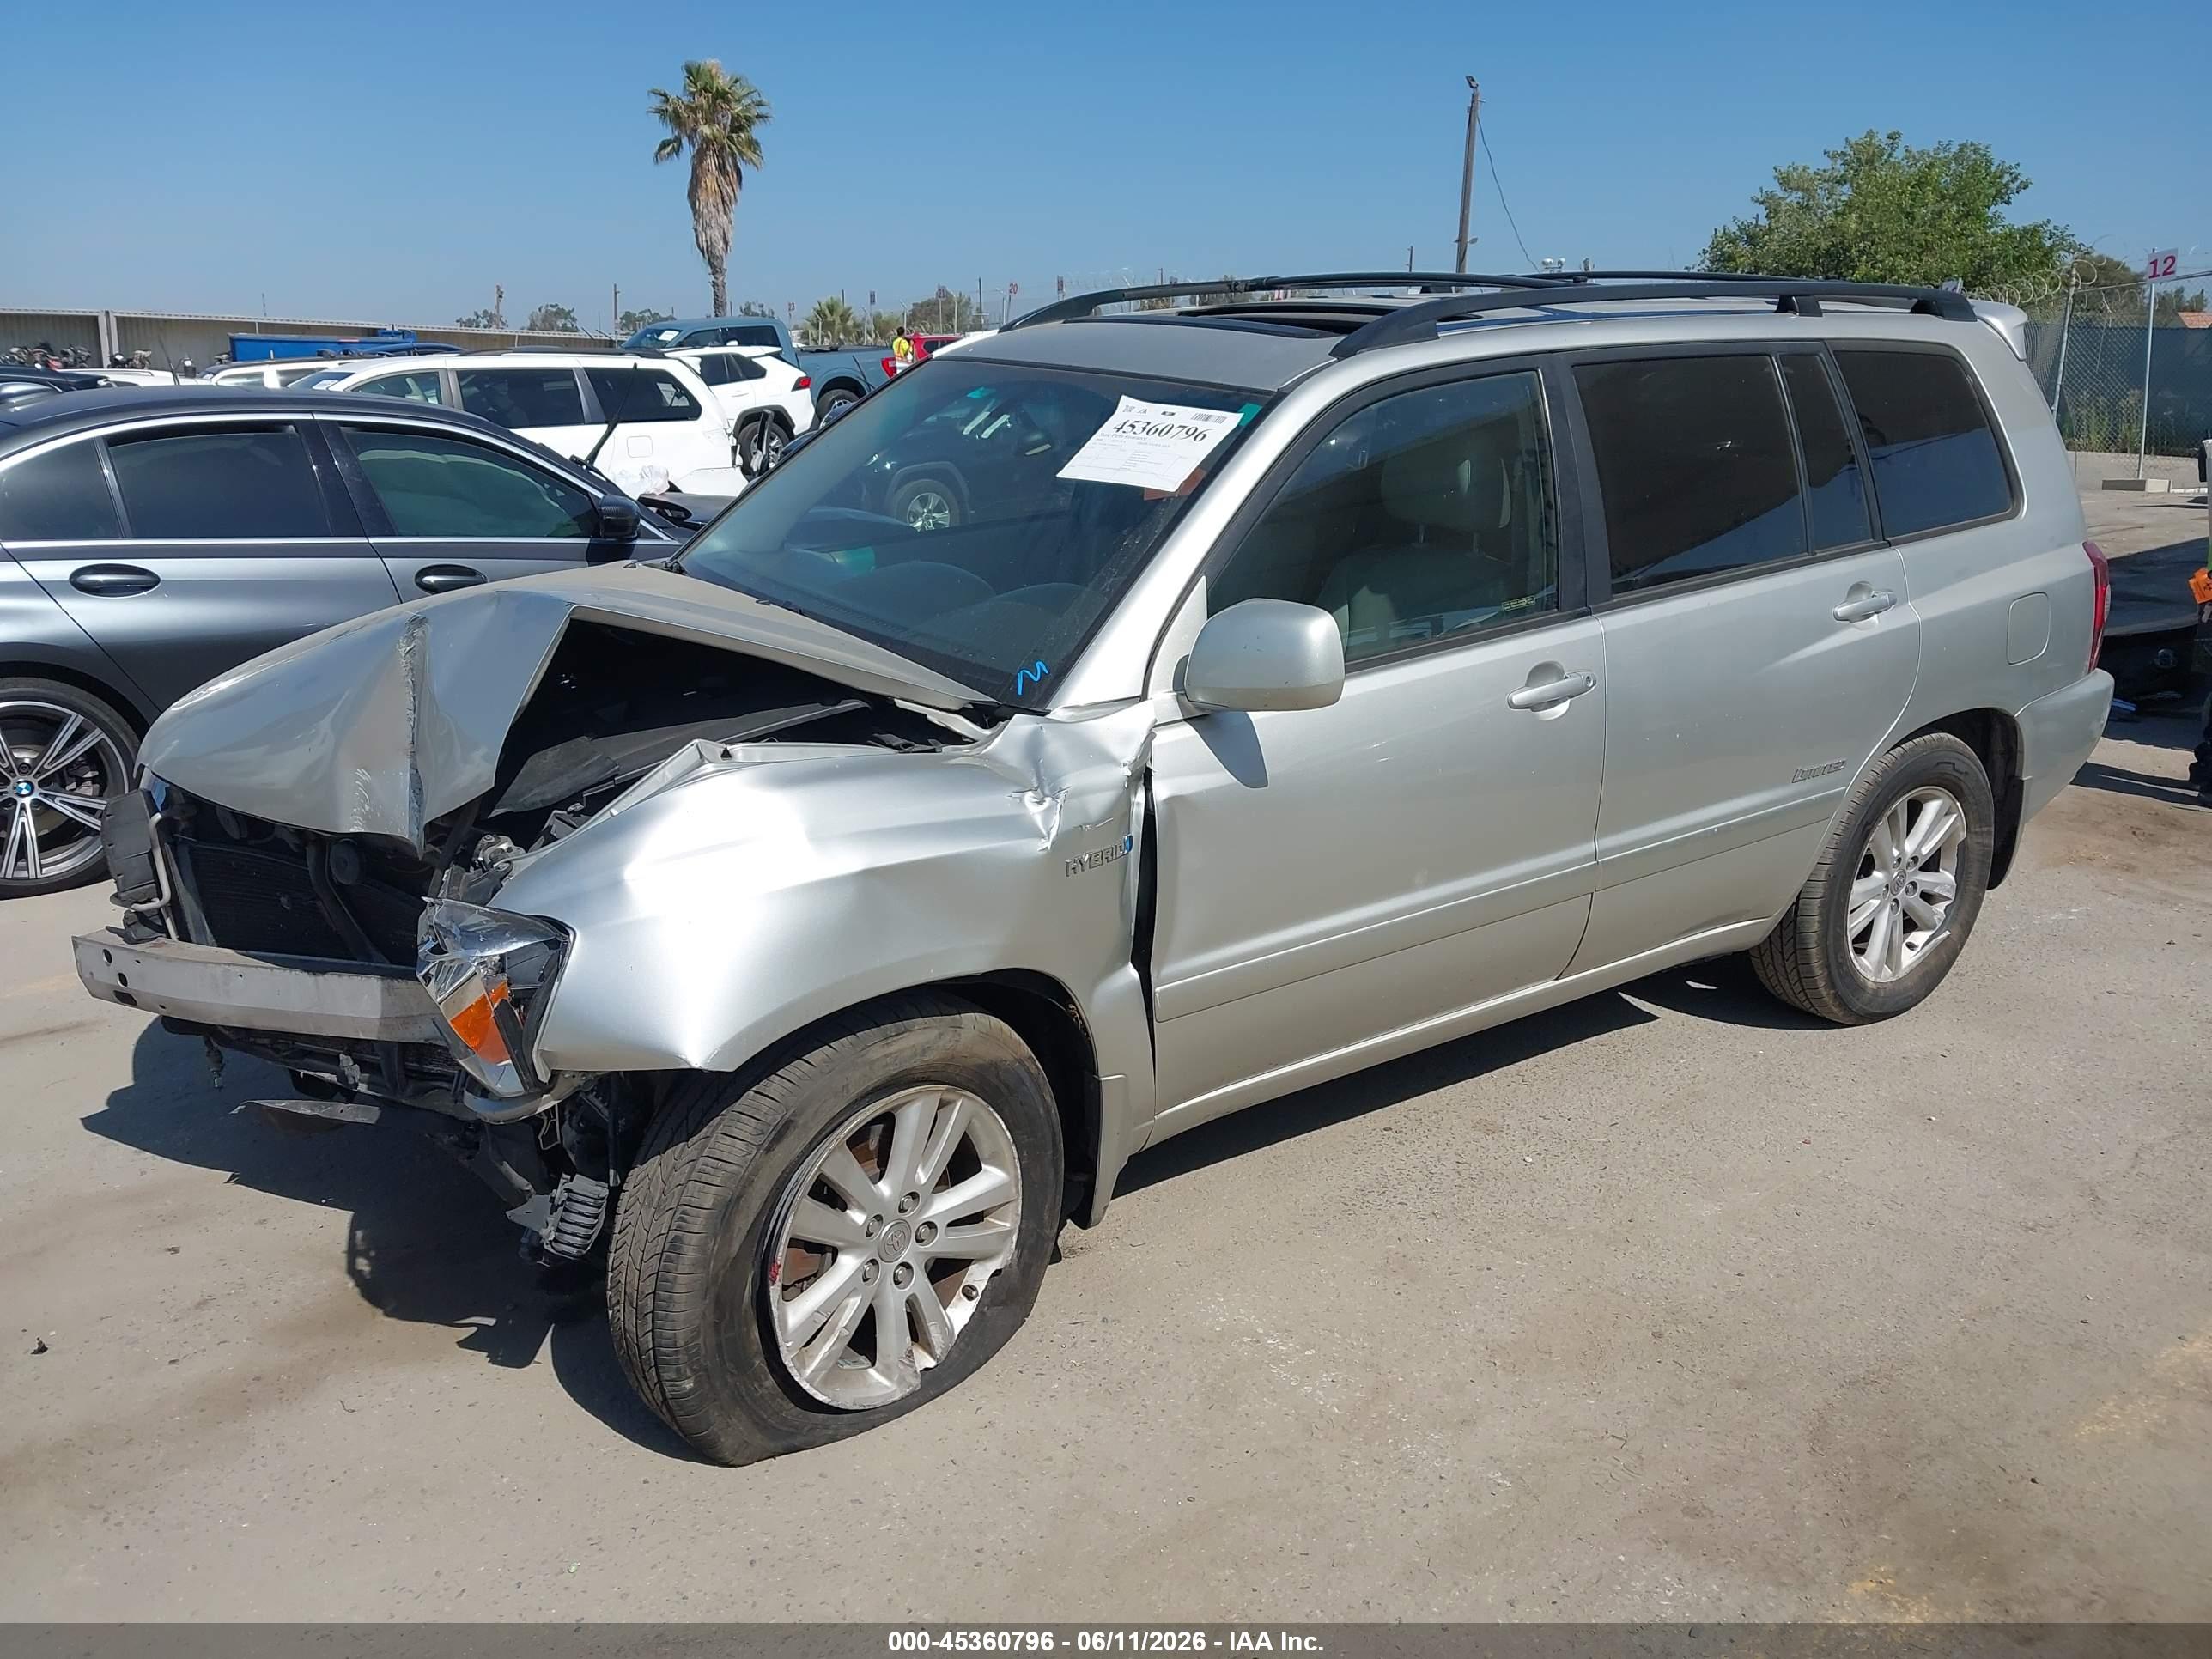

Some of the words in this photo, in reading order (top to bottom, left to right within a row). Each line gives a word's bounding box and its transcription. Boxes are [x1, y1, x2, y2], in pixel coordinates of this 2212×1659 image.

[2148, 255, 2176, 279] 12
[1009, 283, 1018, 295] 20
[1113, 419, 1212, 442] 45360796
[1066, 842, 1127, 877] HYBRID
